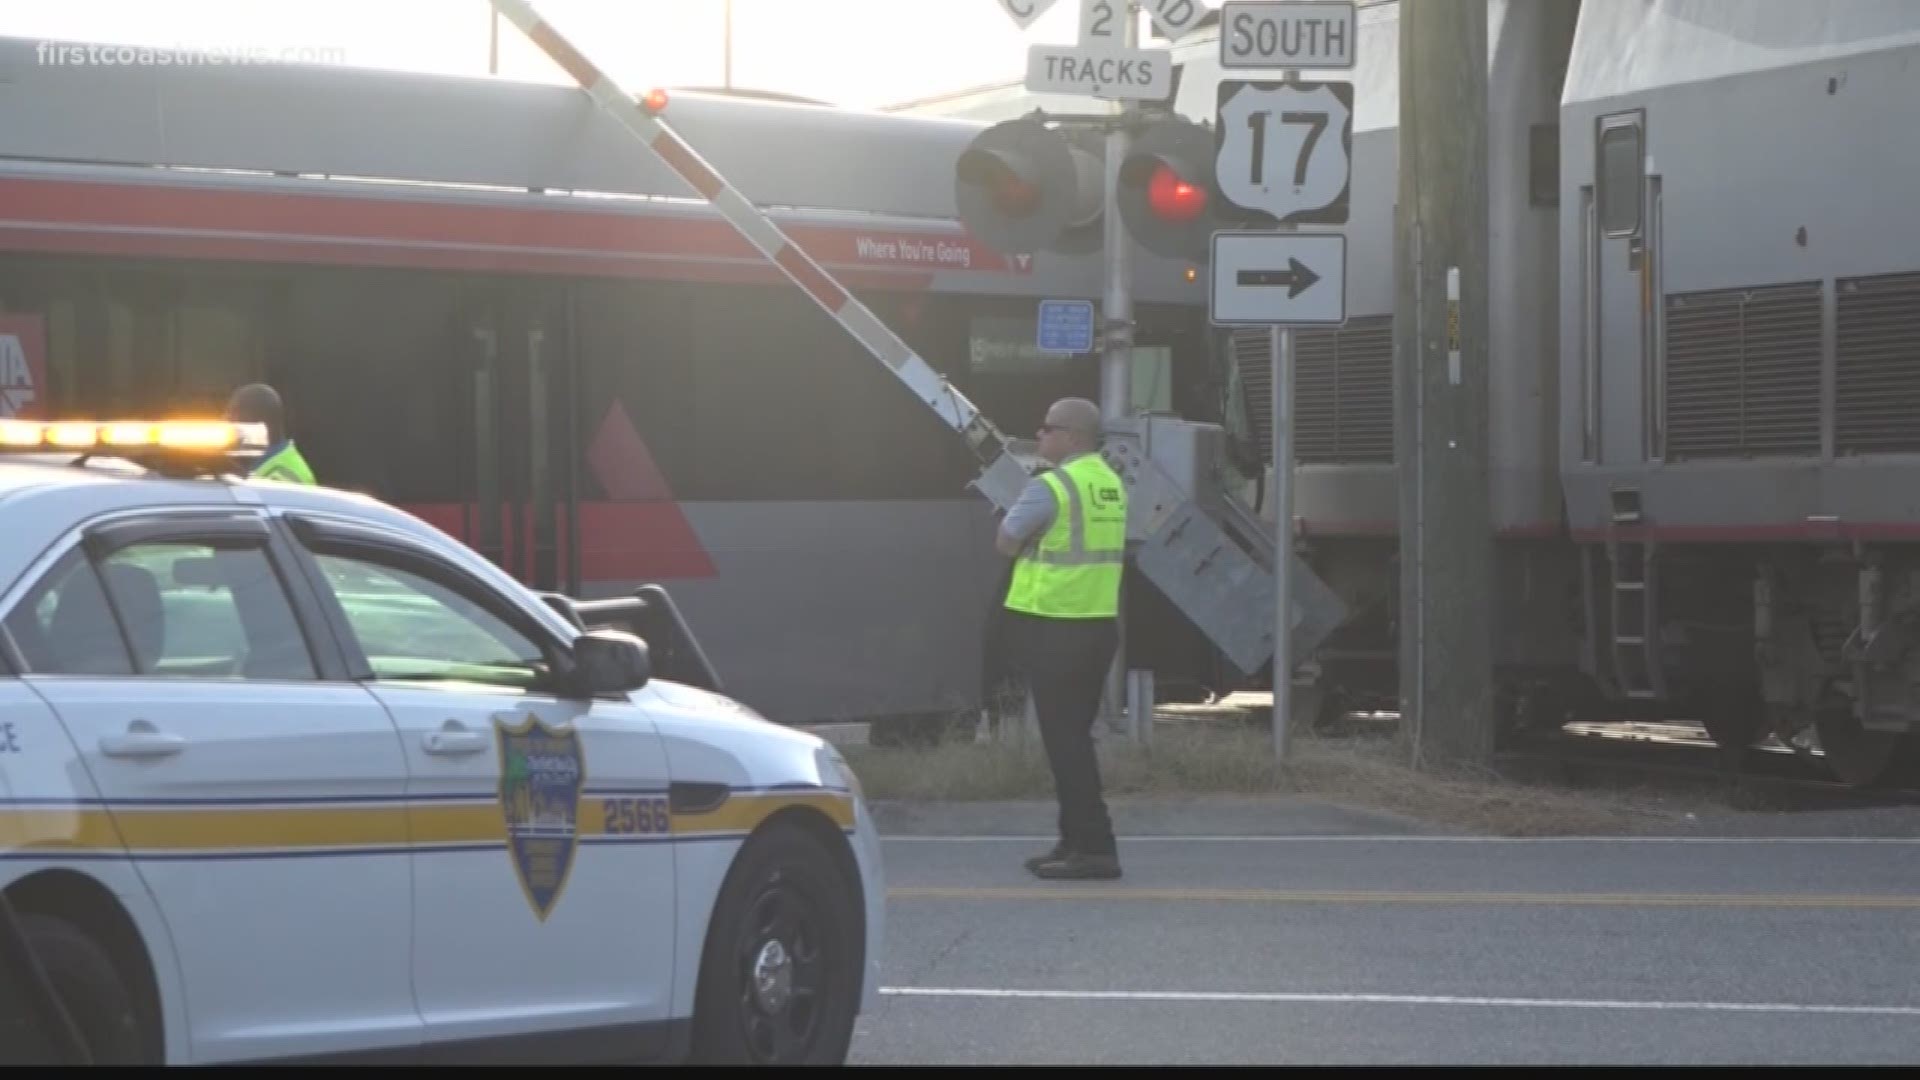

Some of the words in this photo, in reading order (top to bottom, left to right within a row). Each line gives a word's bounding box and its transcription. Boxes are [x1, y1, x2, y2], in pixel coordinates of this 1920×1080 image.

[1090, 4, 1113, 36] 2
[1231, 13, 1345, 57] SOUTH
[1044, 55, 1153, 85] TRACKS
[1247, 110, 1329, 186] 17
[856, 236, 896, 259] Where
[899, 240, 934, 261] You're
[937, 242, 970, 268] Going
[604, 798, 669, 834] 2566
